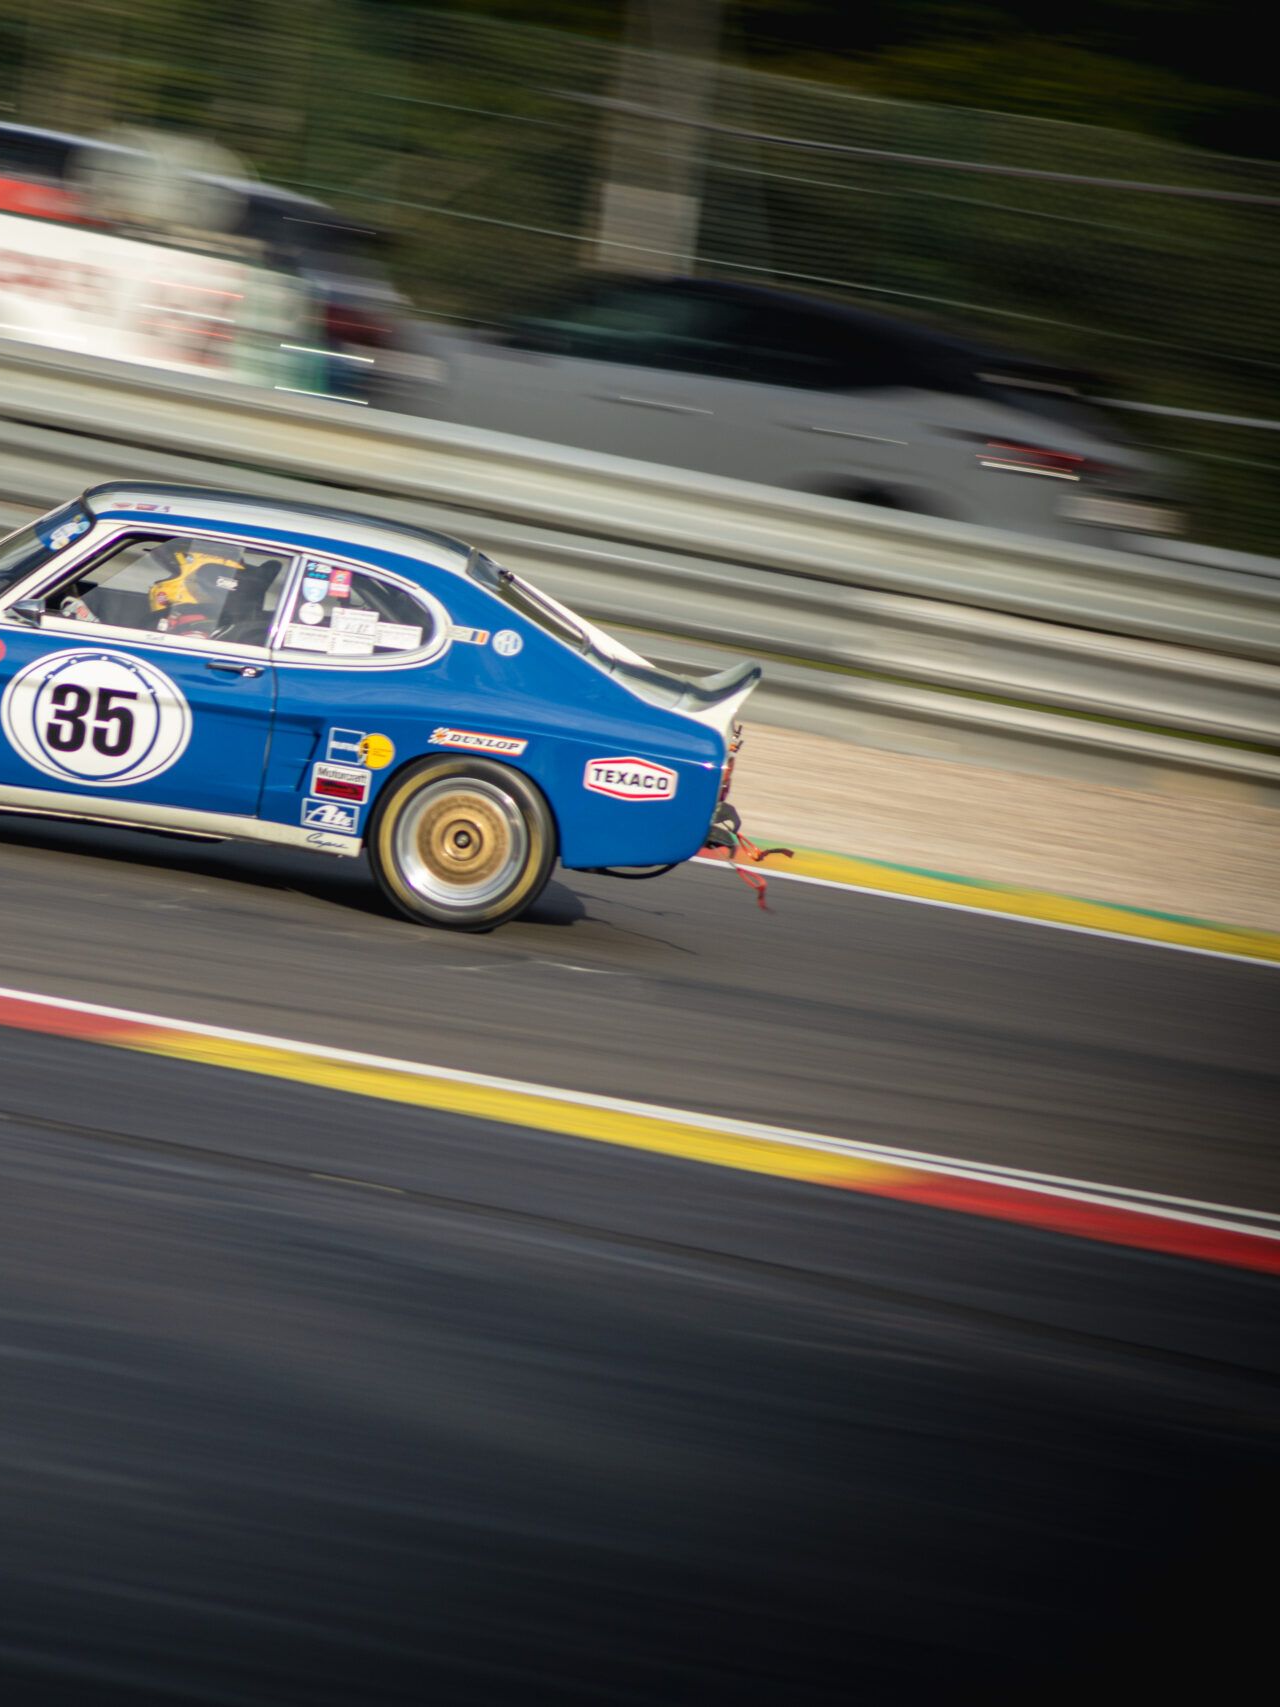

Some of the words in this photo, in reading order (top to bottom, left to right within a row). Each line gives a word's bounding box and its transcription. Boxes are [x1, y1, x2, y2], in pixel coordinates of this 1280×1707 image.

[46, 683, 138, 757] 35
[449, 734, 519, 750] DUNLOP
[317, 767, 367, 784] Motorcraft
[594, 768, 668, 790] TEXACO
